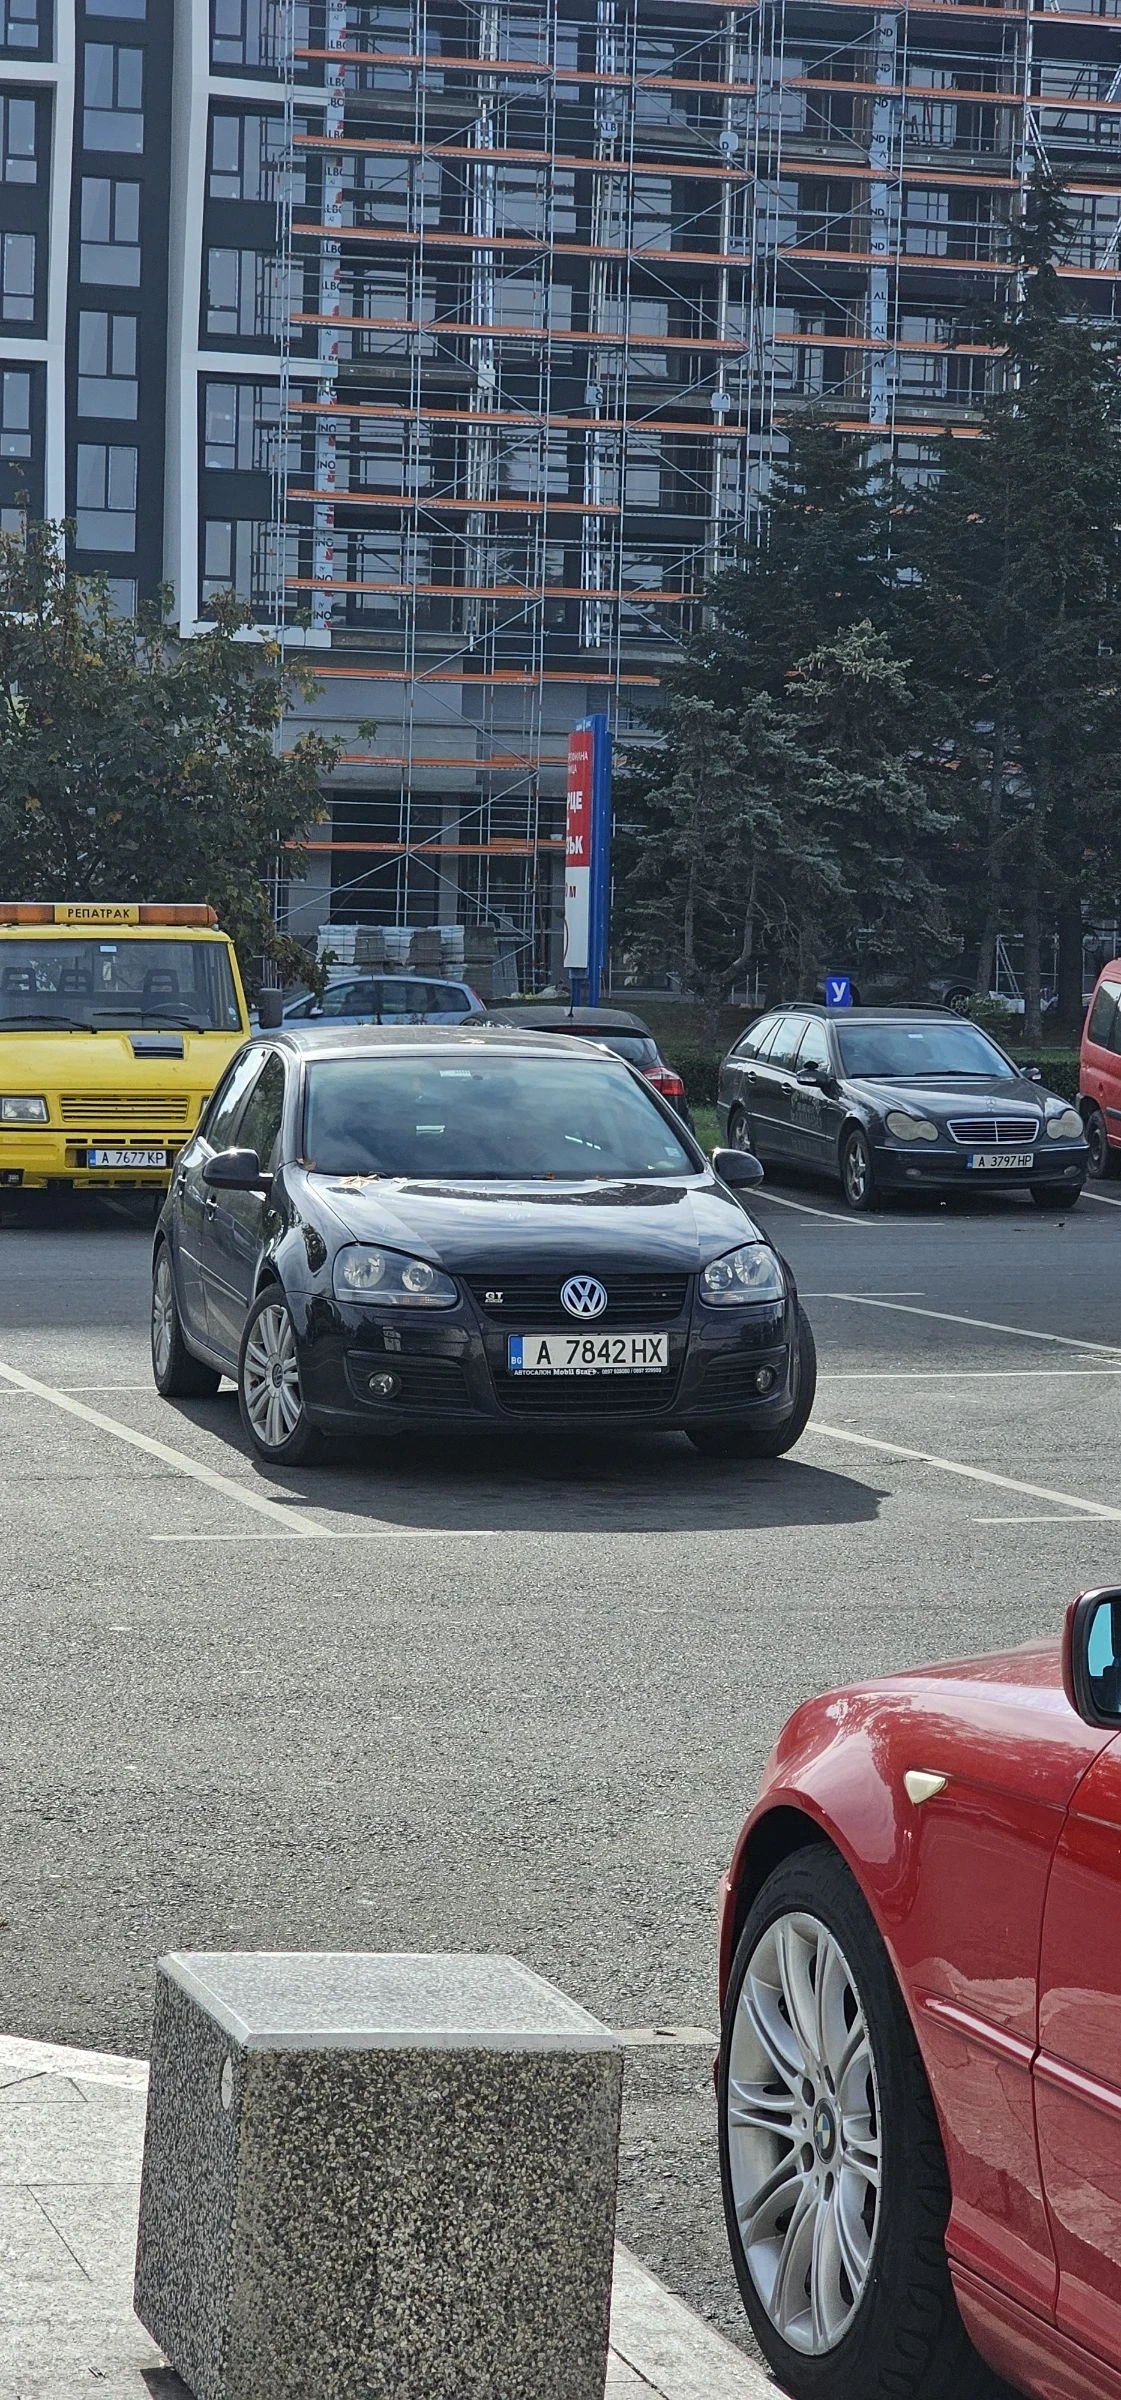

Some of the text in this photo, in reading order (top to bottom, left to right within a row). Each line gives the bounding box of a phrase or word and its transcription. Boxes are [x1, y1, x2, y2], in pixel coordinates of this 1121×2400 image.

[67, 908, 130, 918] РЕПАТРАК
[115, 1152, 145, 1164] 7677
[566, 1339, 626, 1365] 7842
[511, 1356, 522, 1365] BG
